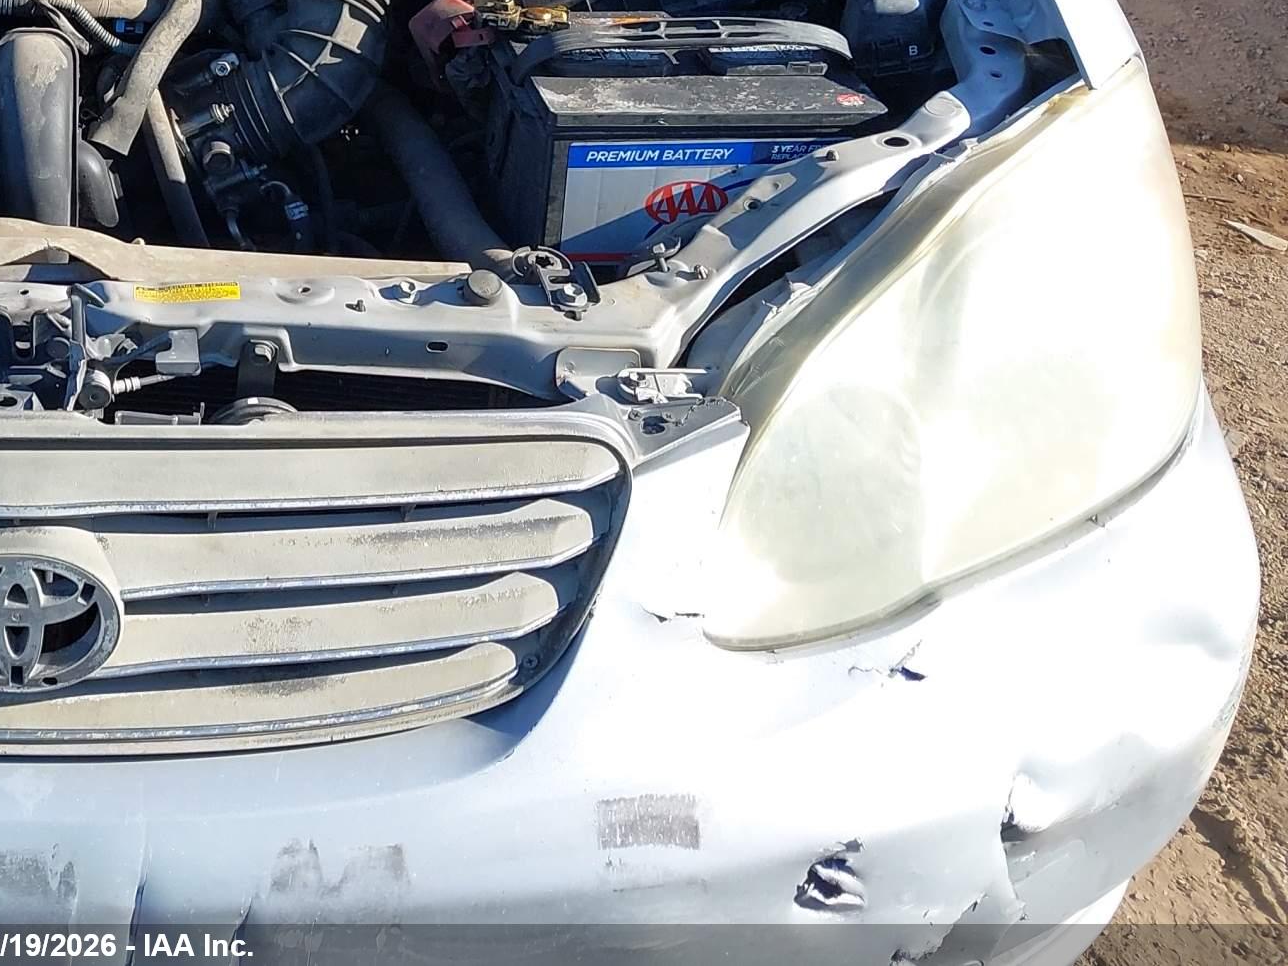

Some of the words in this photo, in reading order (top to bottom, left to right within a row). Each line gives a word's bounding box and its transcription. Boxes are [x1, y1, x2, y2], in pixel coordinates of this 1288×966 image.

[908, 45, 919, 56] B
[586, 149, 659, 163] PREMIUM
[661, 147, 734, 161] BATTERY
[771, 145, 780, 153] 3
[780, 144, 807, 153] YEAR
[647, 179, 724, 223] AAA
